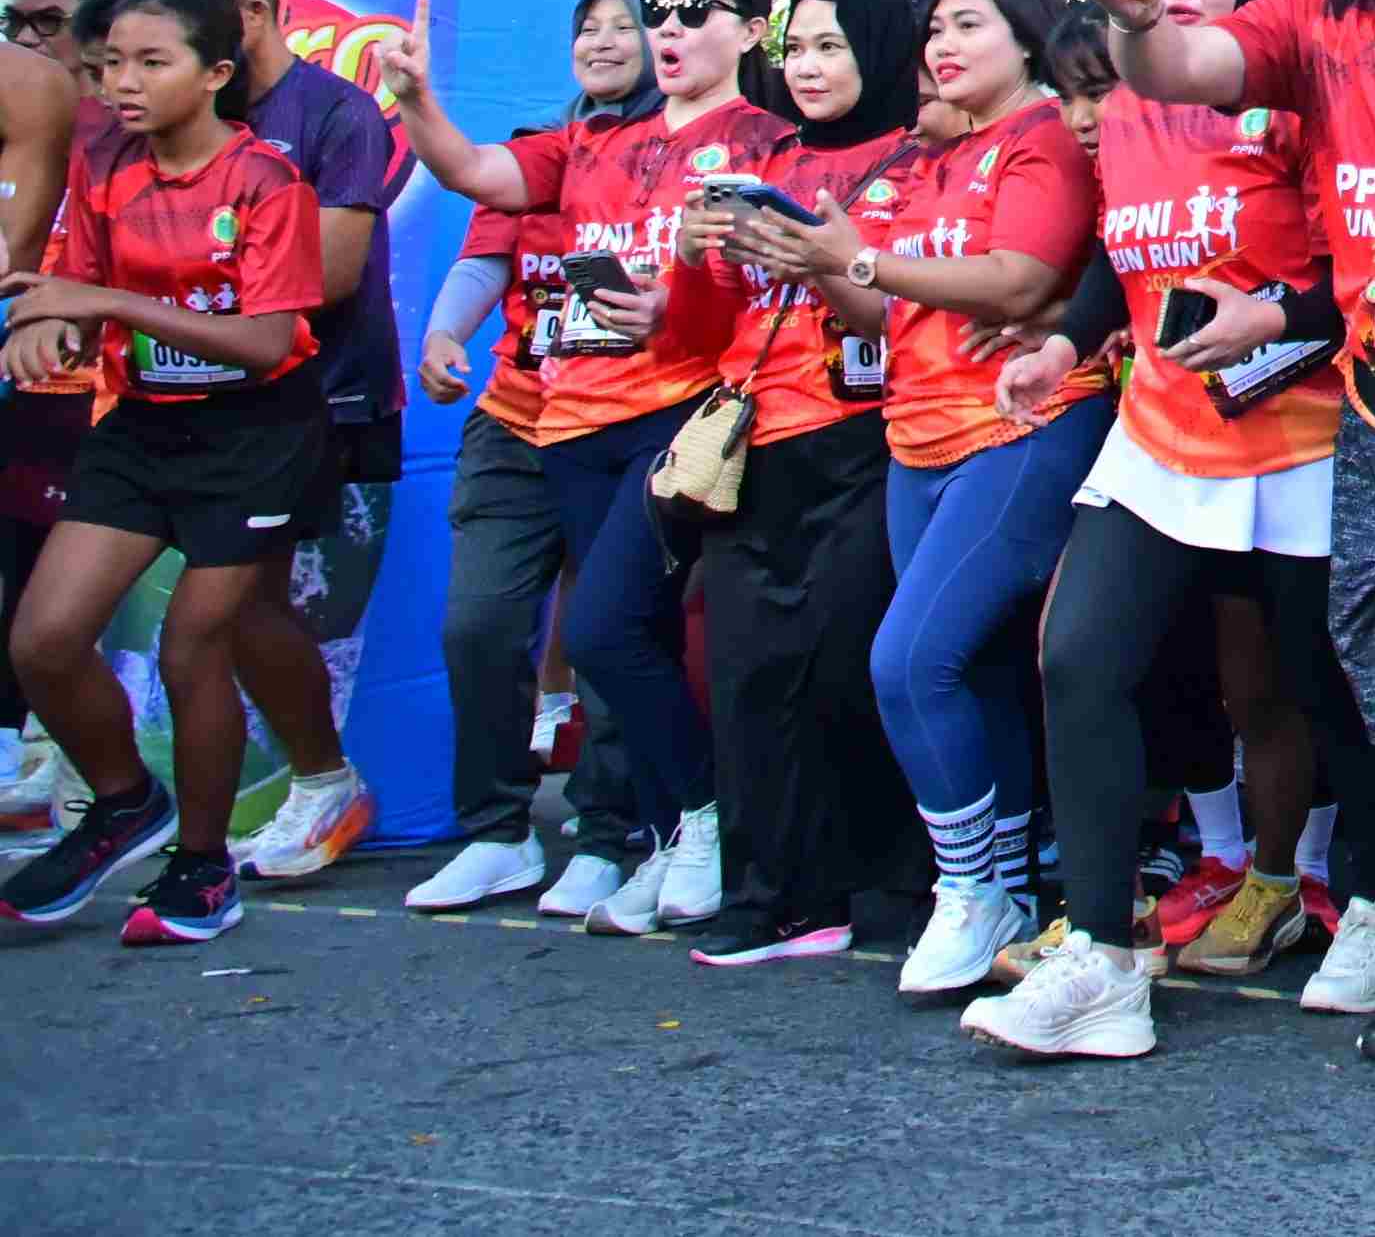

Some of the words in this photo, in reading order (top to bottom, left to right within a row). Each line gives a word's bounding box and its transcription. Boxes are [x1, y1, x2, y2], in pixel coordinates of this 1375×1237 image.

[1230, 145, 1263, 156] PPNI
[968, 181, 989, 193] PP
[862, 210, 893, 220] PPNI
[1104, 202, 1174, 247] PPNI
[211, 250, 231, 262] PP
[1150, 240, 1200, 269] RUN
[522, 253, 566, 281] PP
